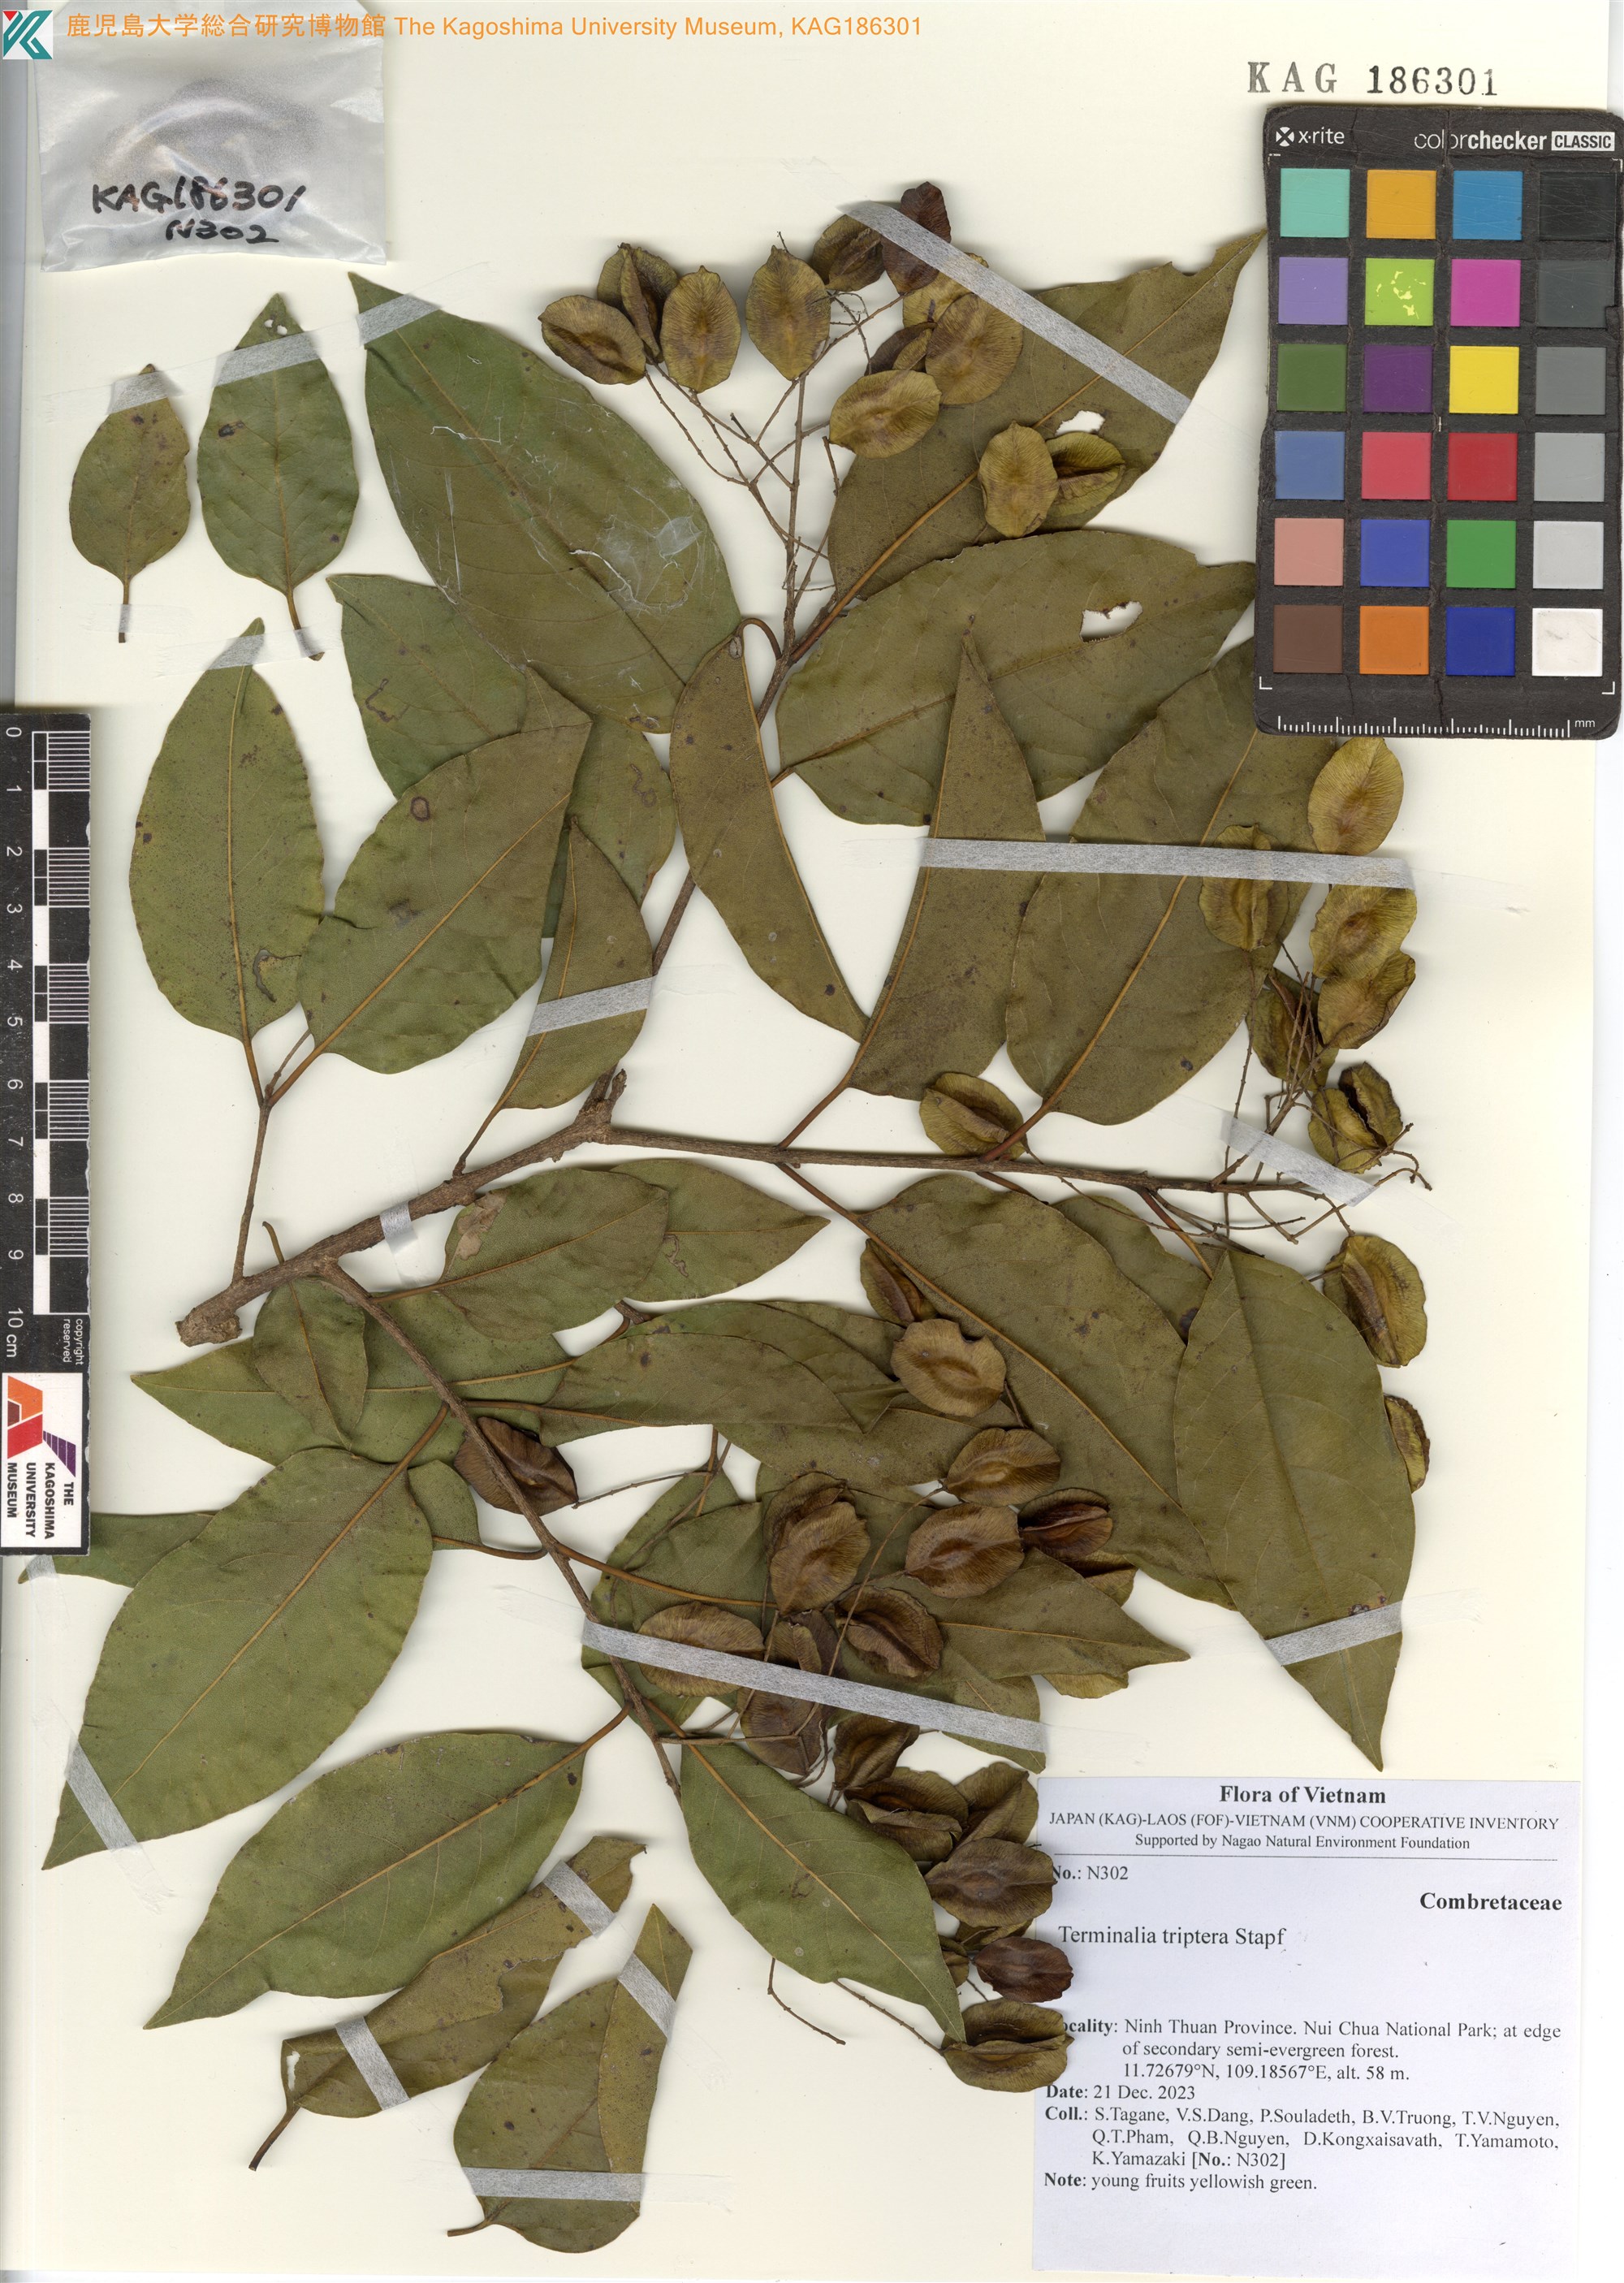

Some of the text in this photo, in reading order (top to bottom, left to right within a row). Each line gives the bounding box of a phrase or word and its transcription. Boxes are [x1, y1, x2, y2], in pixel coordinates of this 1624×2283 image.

[1247, 61, 1497, 96] KAG 186301
[1553, 134, 1612, 149] CLASSIC
[93, 175, 306, 214] KAG186301
[165, 218, 279, 244] N302
[1573, 719, 1596, 729] mm
[6, 726, 24, 1358] 0 1 2 3 4 5 6 7 8 9 10 cm
[63, 1318, 72, 1363] reserved
[73, 1318, 84, 1365] copyright
[6, 1463, 18, 1518] MUSEUM
[25, 1462, 37, 1537] UNIVERSITY
[45, 1462, 55, 1540] KAGOSHIMA
[63, 1481, 74, 1506] THE
[1219, 1785, 1386, 1805] Flora of Vietnam
[1049, 1812, 1559, 1831] JAPAN (KAG)-LAOS (FOF)-VIETNAM (VNM) COOPERATIVE INVENTORY
[1134, 1833, 1470, 1850] Supported by Nagao Natural Environment Foundation
[1086, 1866, 1129, 1881] N302
[1419, 1892, 1562, 1911] Combretaceae
[1057, 1926, 1287, 1950] Terminalia triptera Stapf
[1125, 2018, 1162, 2034] Ninh
[1168, 2019, 1217, 2034] Thuan
[1224, 2020, 1297, 2034] Province.
[1303, 2021, 1332, 2035] Nui
[1338, 2021, 1380, 2036] Chua
[1385, 2021, 1450, 2037] National
[1458, 2022, 1497, 2038] Park;
[1503, 2025, 1518, 2038] at
[1523, 2023, 1561, 2042] edge
[1122, 2040, 1398, 2061] of secondary semi-evergreen forest.
[1124, 2062, 1410, 2081] 11.72679°N, 109.18567°E, alt. 58 m.
[1046, 2084, 1195, 2100] Date: 21 Dec. 2023
[1045, 2106, 1559, 2130] Coll.: S.Tagane, V.S.Dang, P.Souladeth, B.V.Truong, T.V.Nguyen,
[1092, 2129, 1558, 2151] Q.T.Pham, Q.B.Nguyen, D.Kongxaisavath, T.Yamamoto,
[1091, 2151, 1285, 2171] K.Yamazaki [No.: N302]
[1044, 2172, 1317, 2194] Note: young fruits yellowish green.
